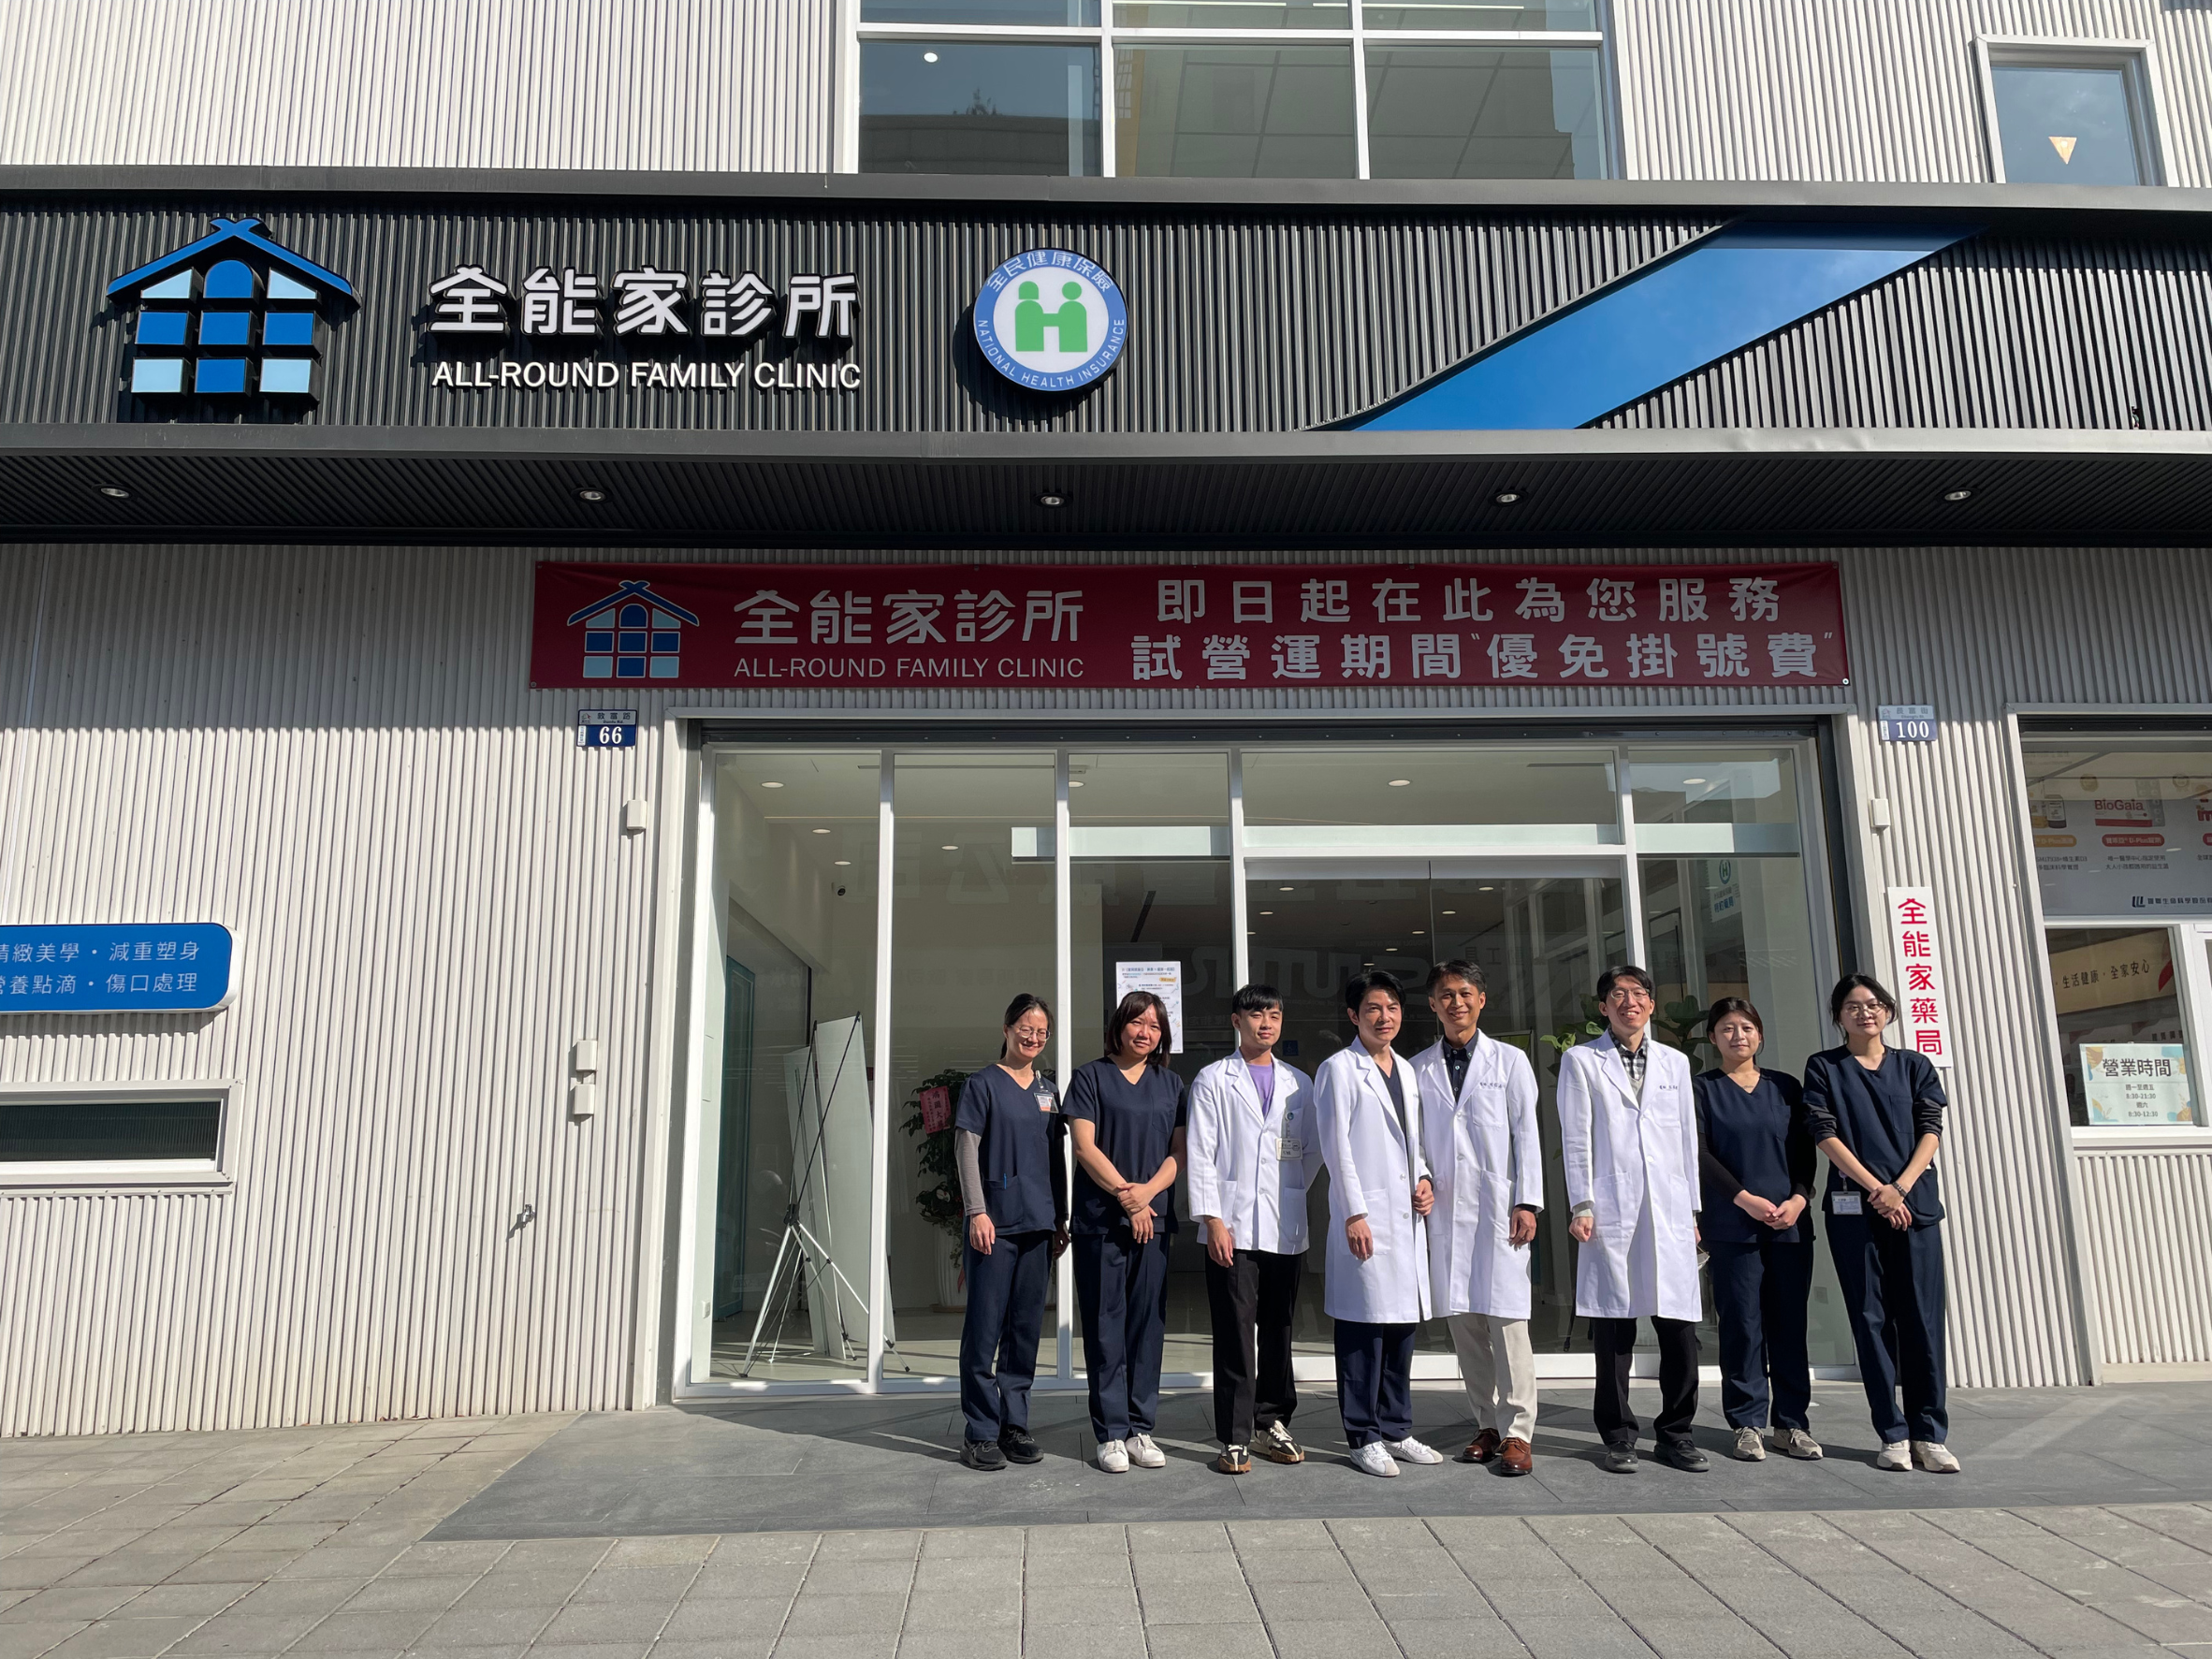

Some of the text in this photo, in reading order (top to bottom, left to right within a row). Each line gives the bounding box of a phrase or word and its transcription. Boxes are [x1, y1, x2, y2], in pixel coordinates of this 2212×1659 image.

[987, 251, 1113, 292] 全民健康保險
[429, 264, 858, 339] 全能家診所
[978, 319, 1125, 387] NATIONAL HEALTH INSURANCE
[432, 361, 861, 390] ALL-ROUND FAMILY CLINIC
[734, 589, 1084, 644] 全能家診所
[1157, 577, 1781, 624] 即日起在此為您服務
[734, 657, 1084, 679] ALL-ROUND FAMILY CLINIC
[599, 726, 622, 744] 66
[1896, 720, 1929, 738] 100
[2094, 798, 2145, 811] BioGaia
[1898, 898, 1943, 1055] 全能家藥局
[2103, 1058, 2172, 1077] 營業時間
